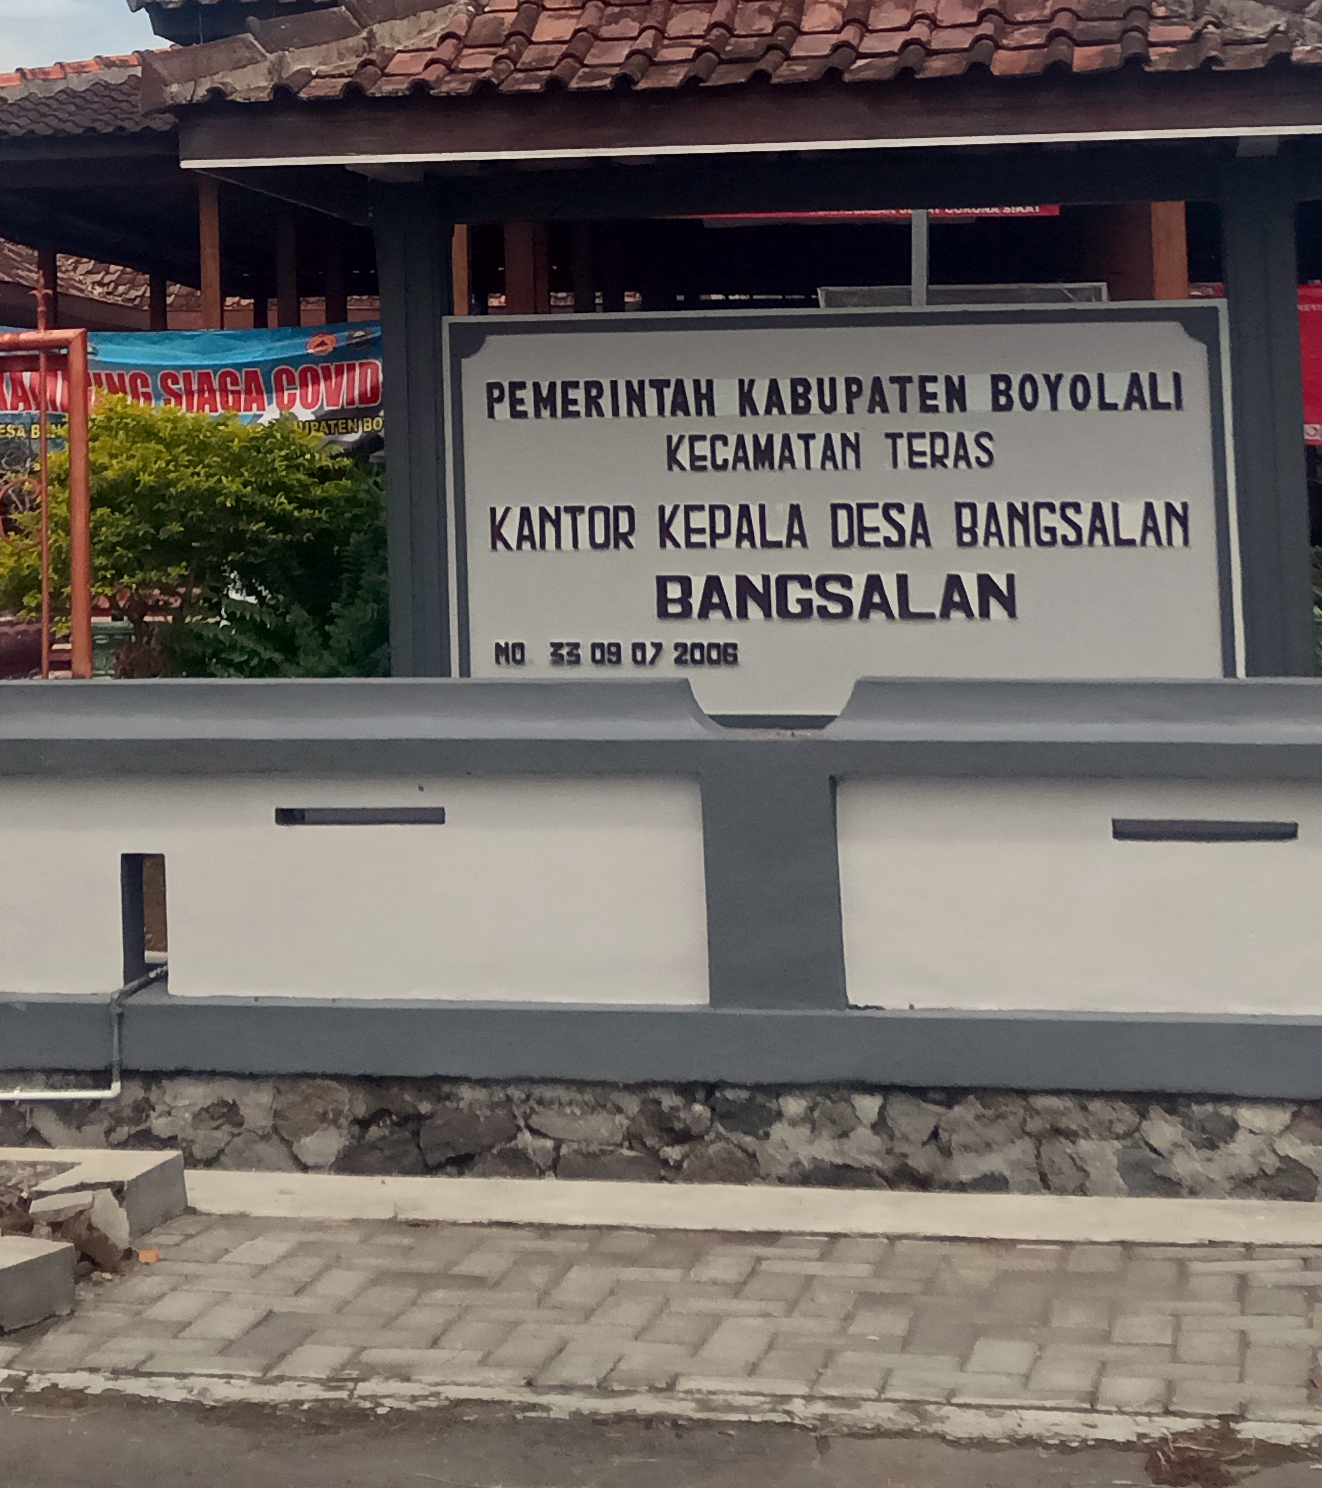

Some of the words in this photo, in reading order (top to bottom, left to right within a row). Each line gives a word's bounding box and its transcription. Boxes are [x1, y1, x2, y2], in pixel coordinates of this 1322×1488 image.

[157, 366, 267, 413] SIAGA
[272, 359, 383, 411] COVID
[485, 377, 716, 419] PEMERINTAH
[737, 373, 969, 416] KABUPATEN
[990, 370, 1183, 412] BOYOLALI
[666, 433, 862, 473] KECAMATAN
[885, 430, 995, 470] TERAS
[489, 504, 636, 552] KANTOR
[659, 503, 809, 550] KEPALA
[831, 502, 933, 549] DESA
[954, 500, 1190, 549] BANGSALAN
[655, 573, 1019, 621] BANGSALAN
[550, 642, 581, 667] 33
[590, 642, 623, 667] 09
[631, 642, 664, 667] 07
[673, 642, 739, 667] 2006
